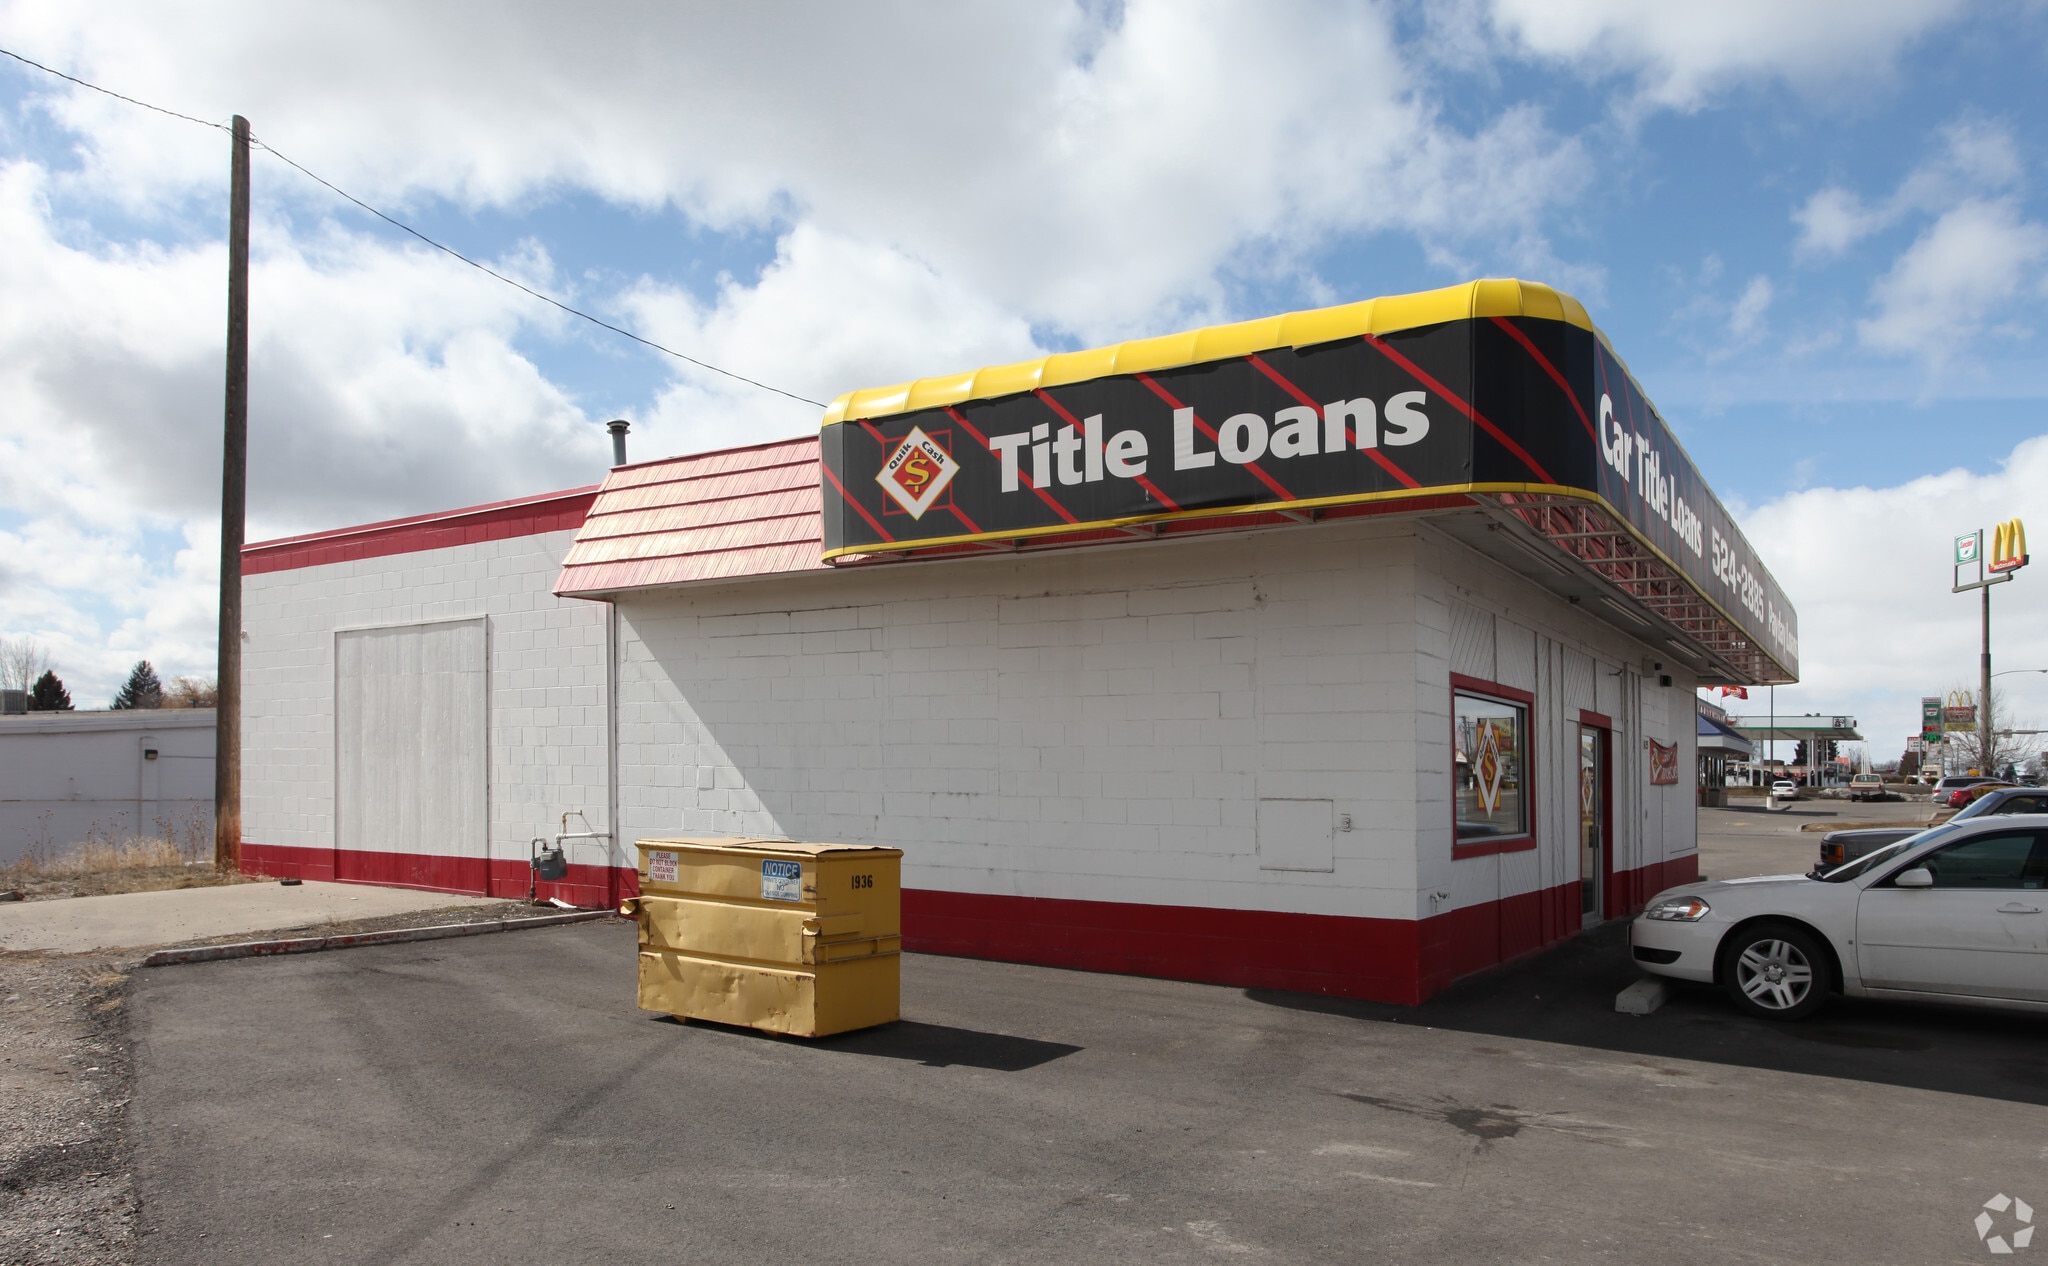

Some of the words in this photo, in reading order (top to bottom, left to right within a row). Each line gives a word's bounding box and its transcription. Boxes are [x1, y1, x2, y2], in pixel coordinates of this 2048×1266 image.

[889, 443, 911, 470] Quik
[922, 441, 945, 464] Cash
[989, 413, 1149, 493] Title
[1174, 390, 1430, 471] Loans
[1600, 394, 1632, 482] Car
[1635, 431, 1668, 522] Title
[1670, 474, 1702, 559] Loans
[1712, 526, 1764, 623] 524-2885
[764, 862, 798, 877] NOTICE
[852, 875, 873, 889] 1936
